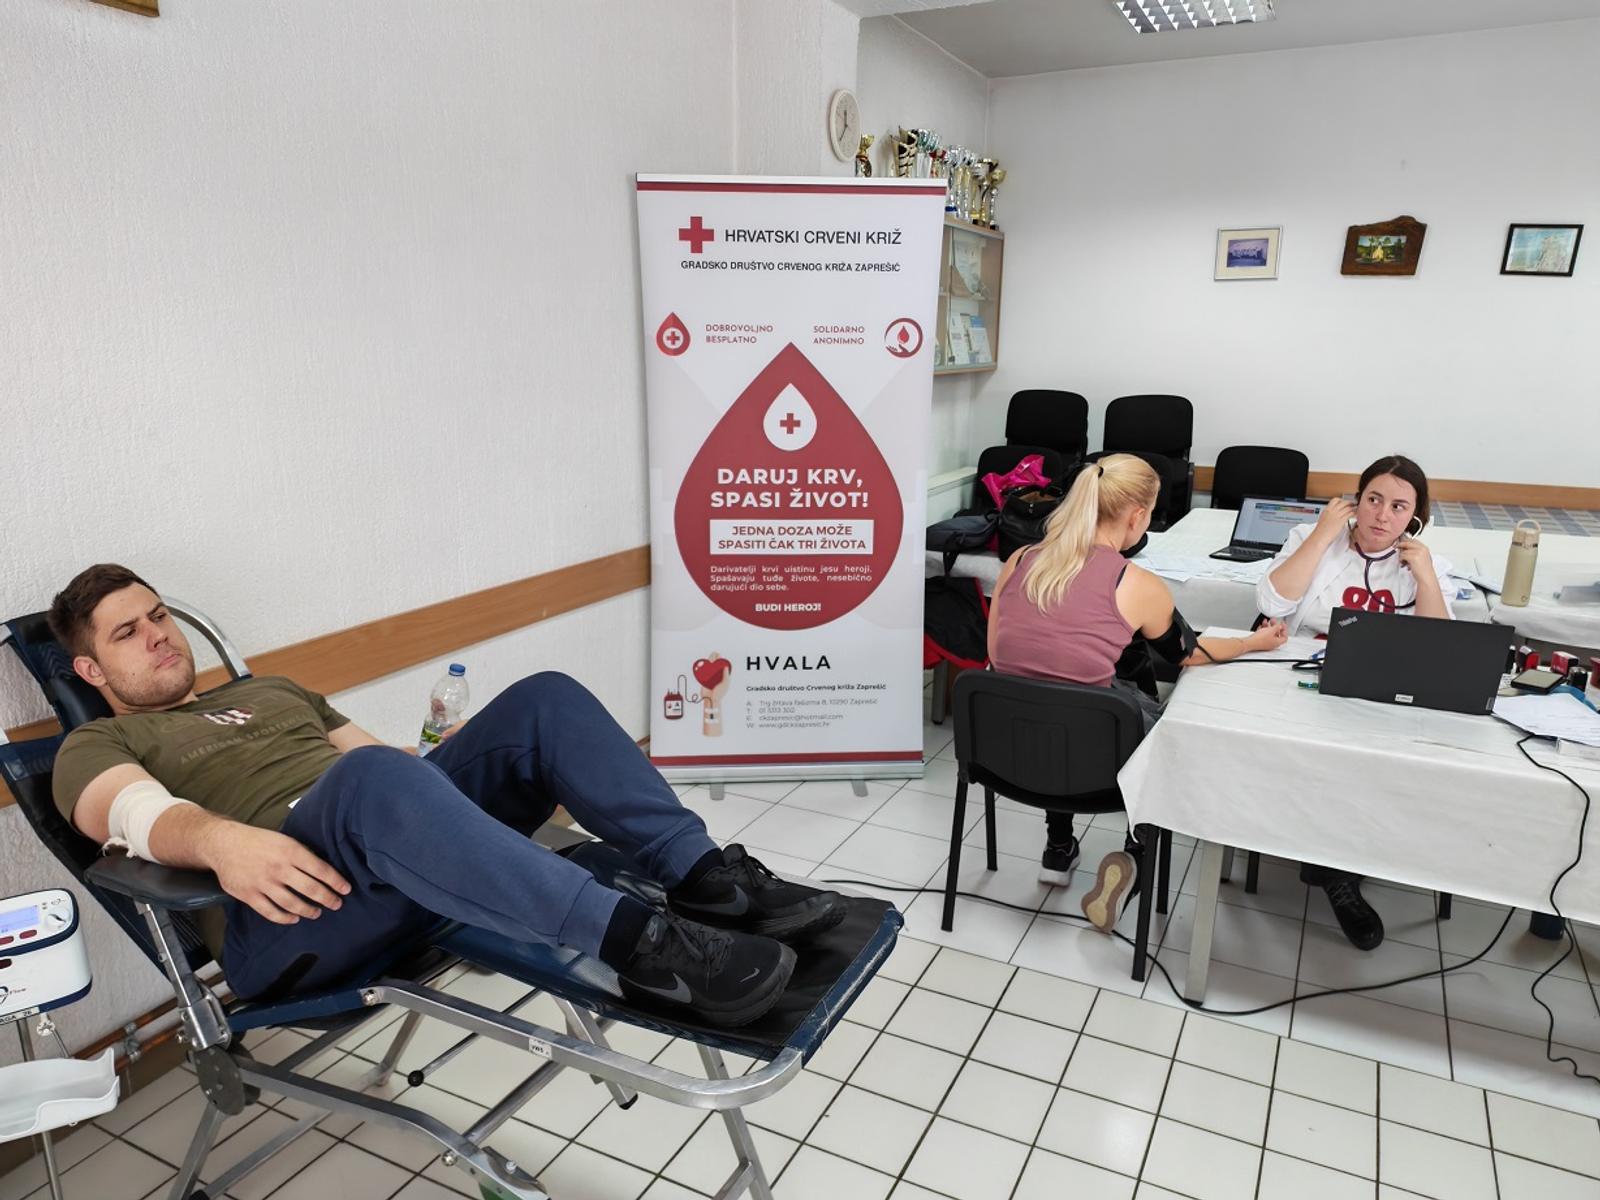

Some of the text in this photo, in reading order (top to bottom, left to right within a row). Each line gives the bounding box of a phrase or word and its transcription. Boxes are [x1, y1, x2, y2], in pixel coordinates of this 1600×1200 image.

[725, 228, 902, 245] HRVATSKI CRVENI KRIŽ
[681, 260, 901, 273] GRADSKO DRUŠTVO CRVENOG KRIŽA ZAPREŠIĆ
[705, 323, 773, 334] DOBROVOLJNO
[813, 325, 865, 334] SOLIDARNO
[705, 335, 757, 344] BESPLATNO
[813, 337, 865, 345] ANONIMNO
[717, 468, 863, 488] DARUJ KRV,
[710, 487, 868, 508] SPASI ŽIVOT!
[732, 523, 853, 536] JEDNA DOZA MOŽE
[718, 537, 866, 550] SPASITI ČAK TRI ŽIVOTA
[710, 565, 872, 574] Darivatelji krvi uistinu jesu heroji.
[710, 574, 755, 583] Spašavaju
[762, 574, 784, 582] tuđe
[827, 574, 873, 582] nesebično
[710, 583, 789, 592] darujući dio sebe.
[755, 603, 781, 612] BUDI
[746, 655, 832, 671] HVALA
[777, 684, 805, 692] društvo
[806, 684, 836, 692] Crvenog
[181, 735, 244, 765] AMERICAN
